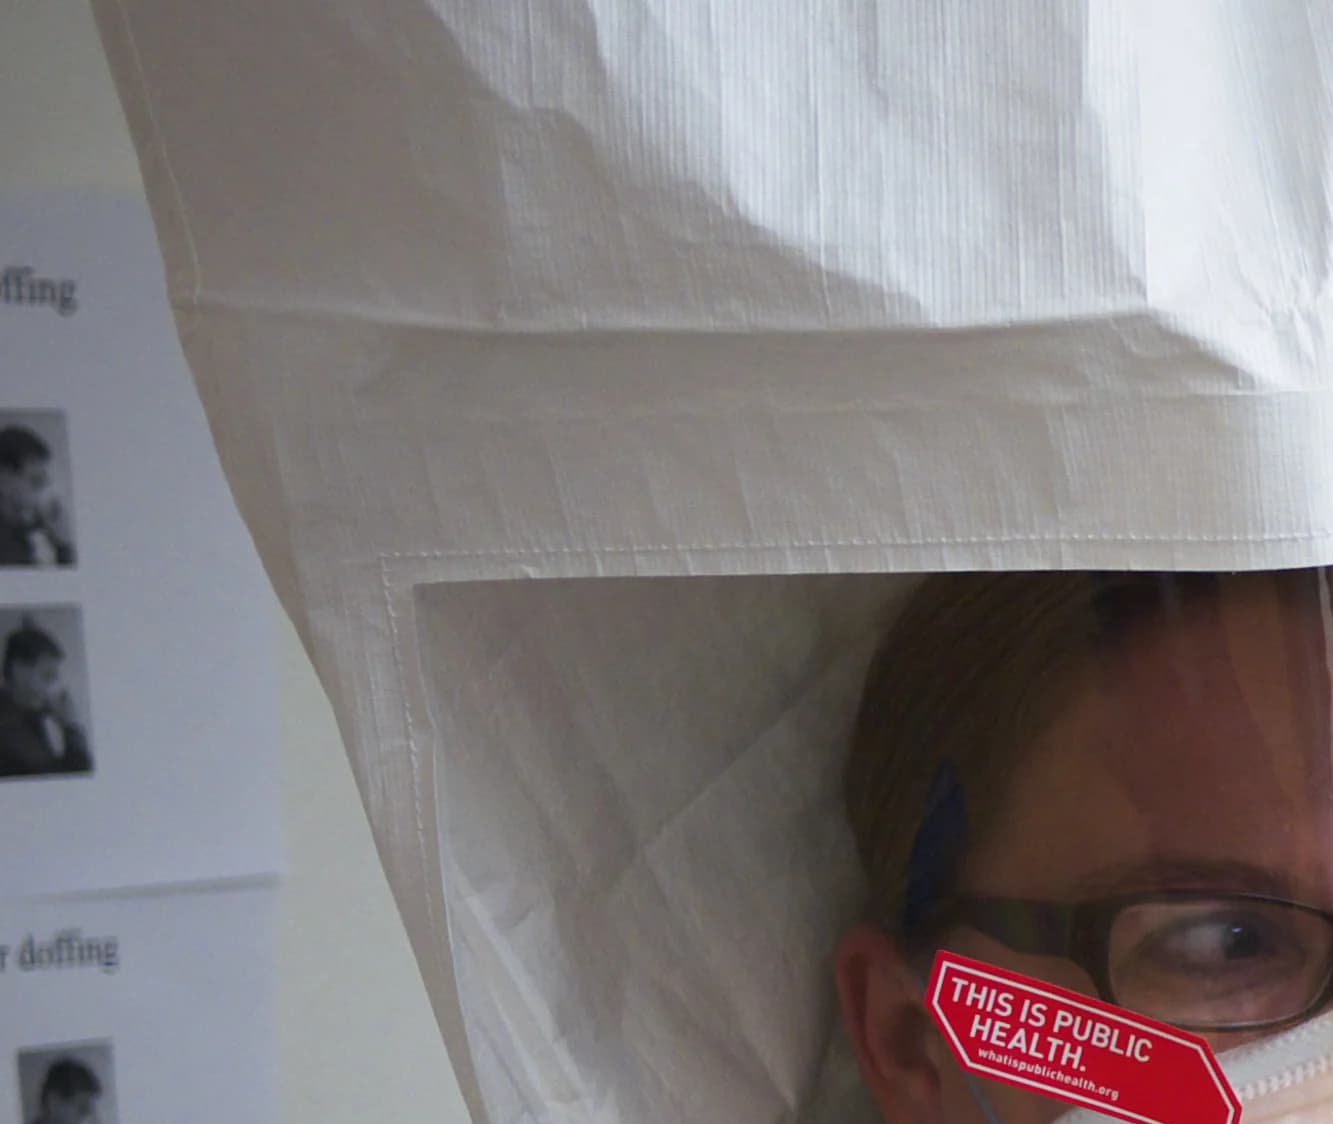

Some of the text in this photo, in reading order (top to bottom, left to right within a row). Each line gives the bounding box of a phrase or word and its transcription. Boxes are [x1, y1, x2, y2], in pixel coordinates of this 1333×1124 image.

[0, 265, 79, 318] ffing
[951, 976, 1153, 1062] THIS IS PUBLIC
[969, 1013, 1086, 1072] HEALTH.
[977, 1047, 1119, 1101] whatispublichealth.org
